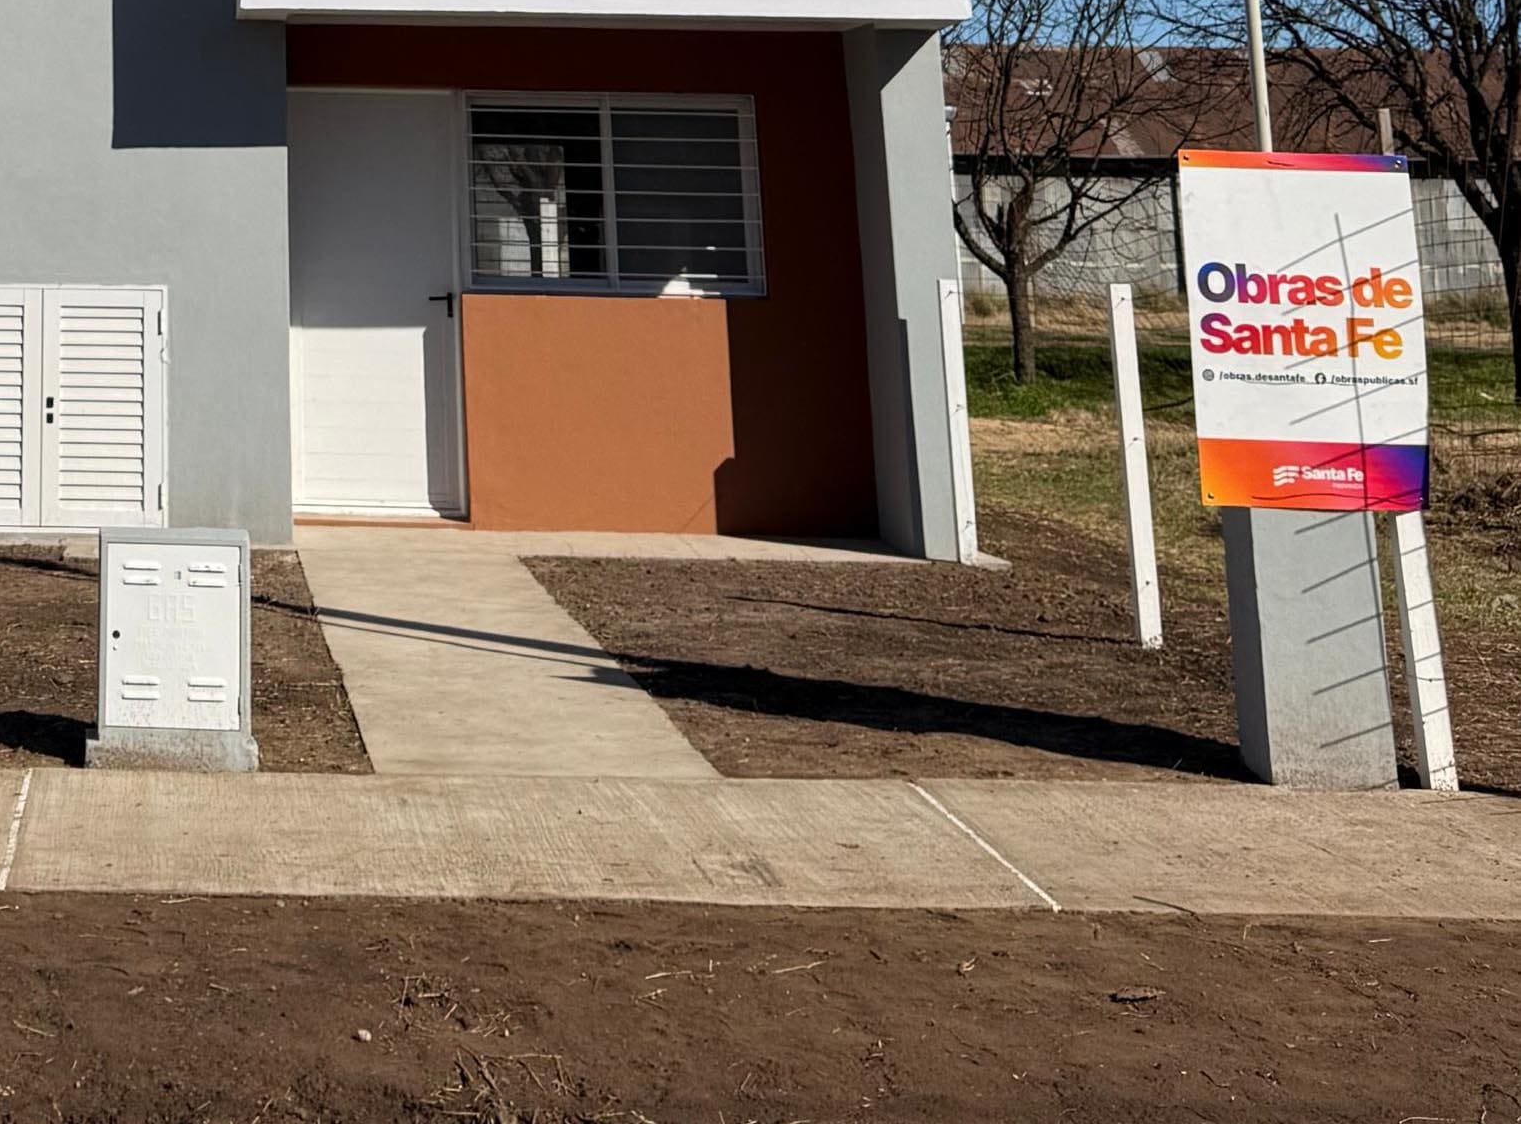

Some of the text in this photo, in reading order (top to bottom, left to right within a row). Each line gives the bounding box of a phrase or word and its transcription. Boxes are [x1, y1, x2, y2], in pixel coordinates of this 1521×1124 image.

[1197, 262, 1413, 308] Obras de
[1200, 313, 1404, 360] Santa Fe
[1301, 465, 1365, 482] Santa Fe
[148, 594, 197, 624] GAS
